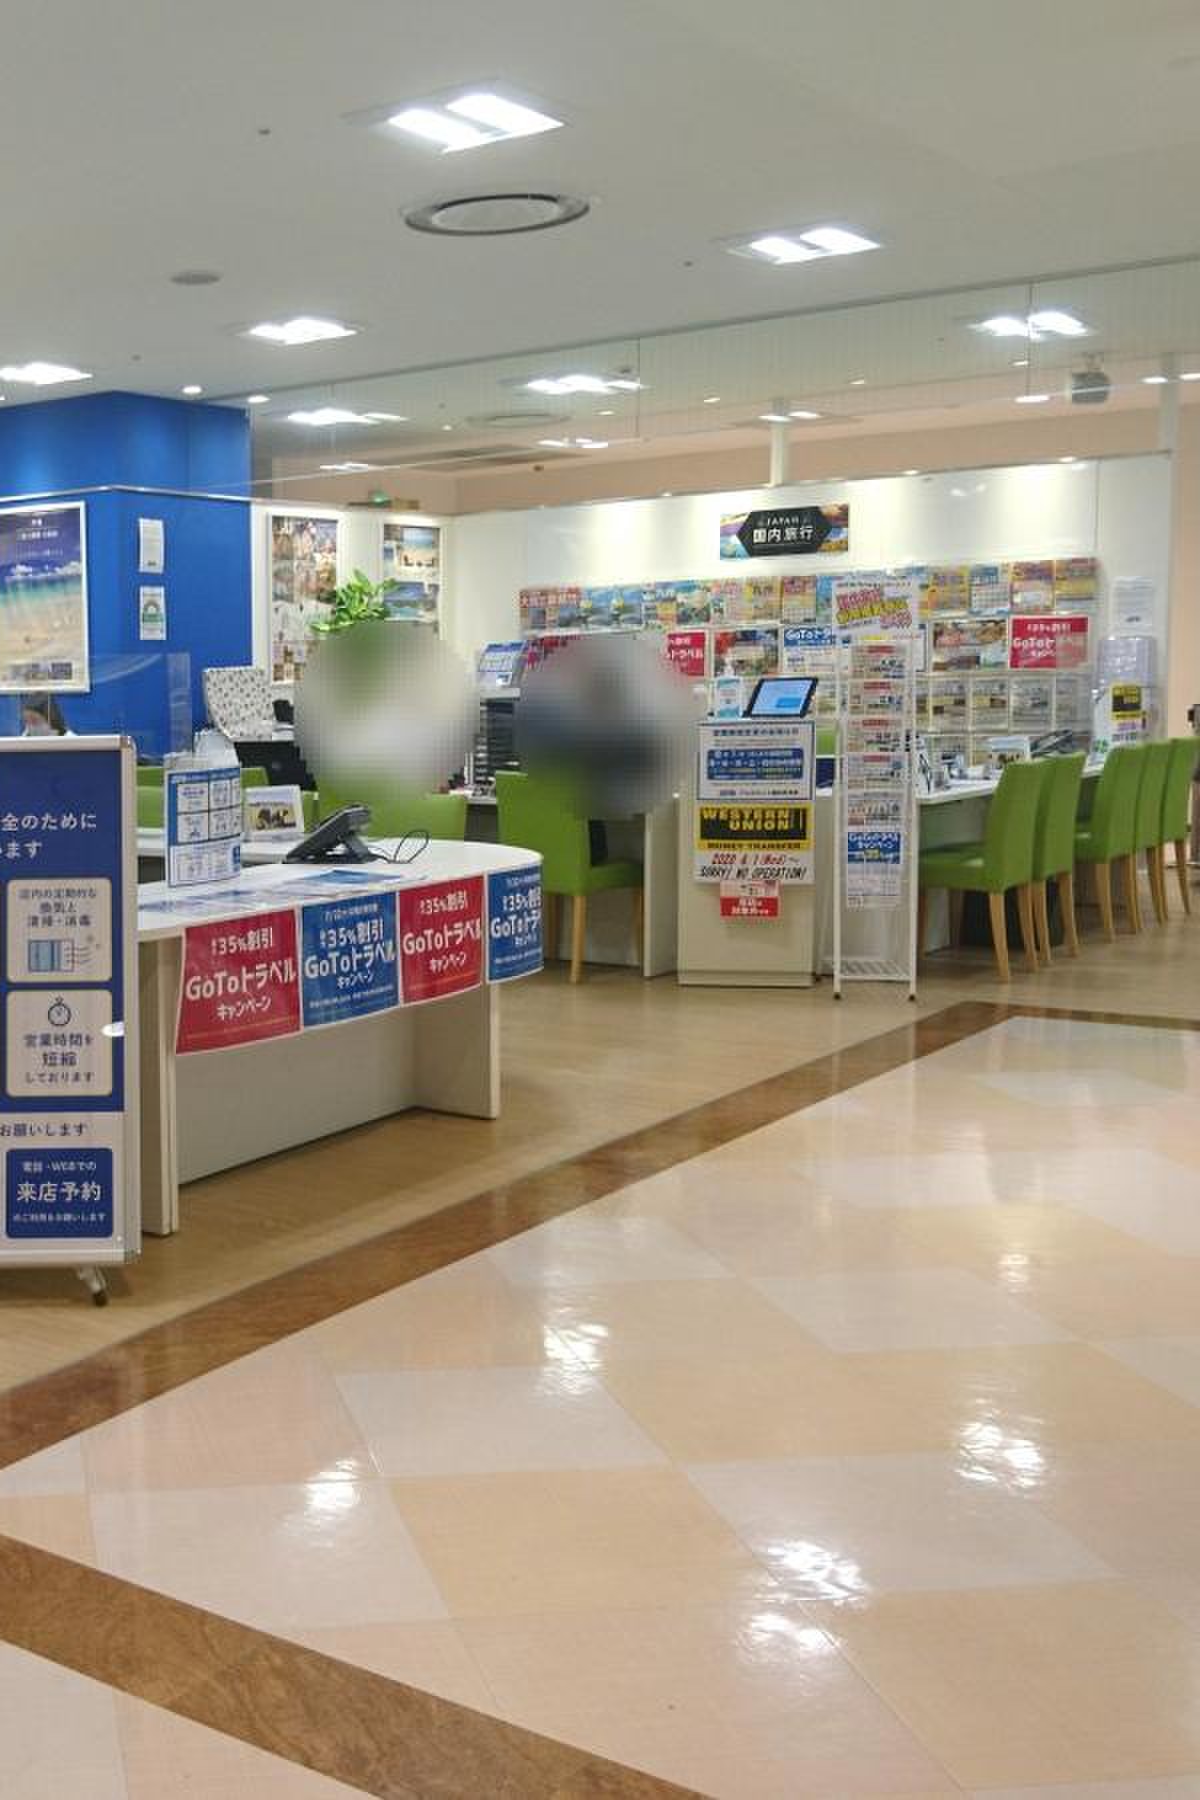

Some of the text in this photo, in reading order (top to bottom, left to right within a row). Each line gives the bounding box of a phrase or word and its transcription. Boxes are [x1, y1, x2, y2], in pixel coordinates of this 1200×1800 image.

[752, 525, 814, 544] 国内旅行
[702, 807, 790, 820] WESTERN
[728, 819, 790, 831] UNION
[304, 939, 397, 979] GoToトラベル
[185, 957, 297, 1001] GoToトラベル
[216, 995, 272, 1021] キャンペーン
[41, 1051, 77, 1067] 短縮
[24, 1071, 94, 1085] しております
[16, 1181, 102, 1203] 来店予約
